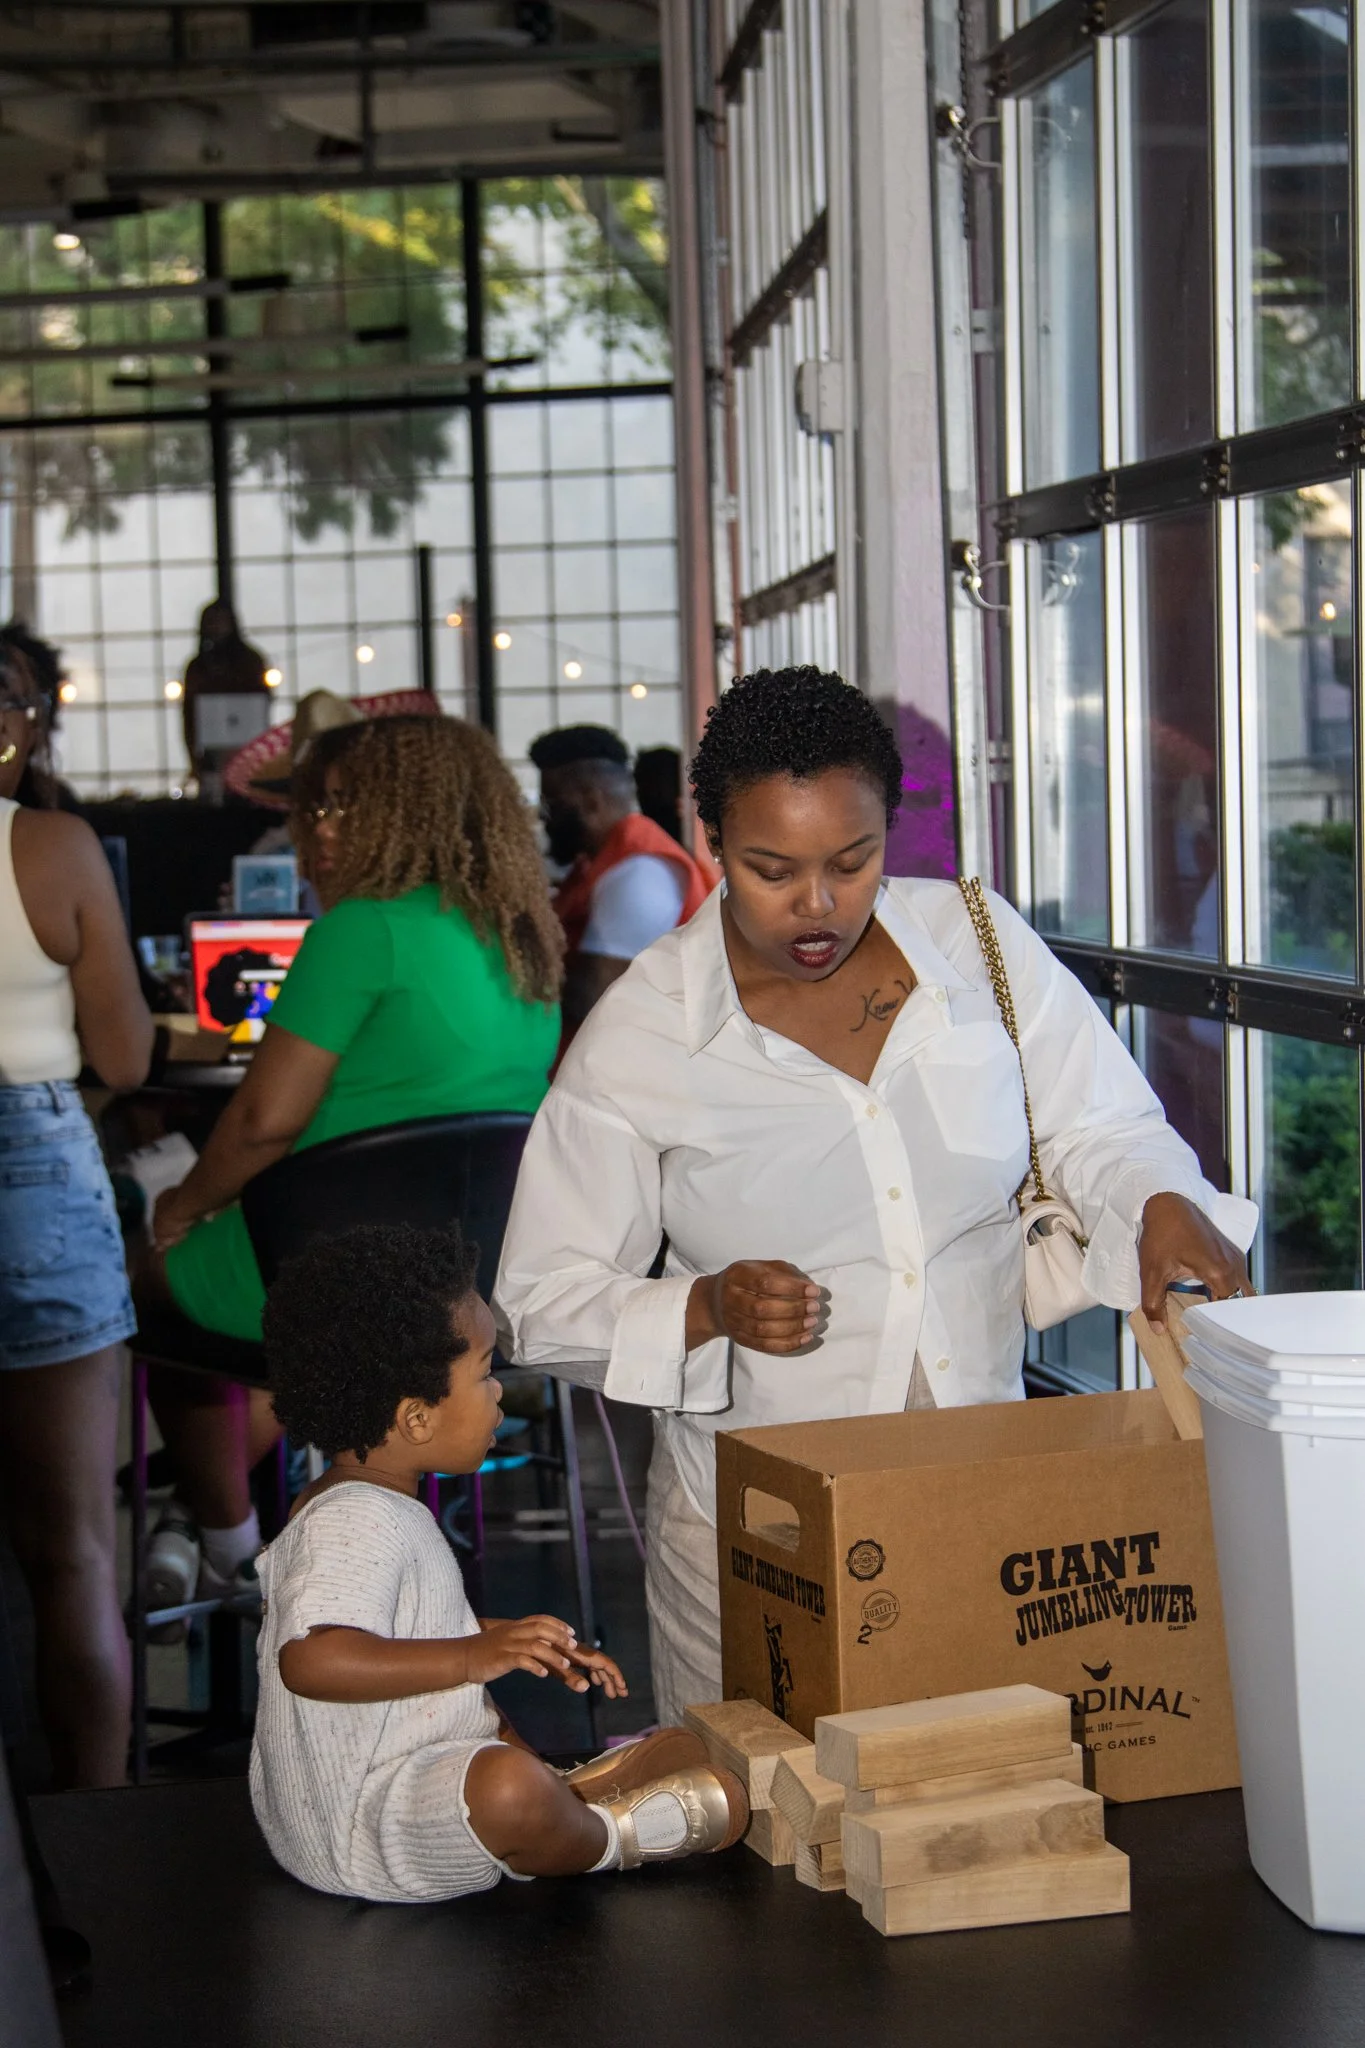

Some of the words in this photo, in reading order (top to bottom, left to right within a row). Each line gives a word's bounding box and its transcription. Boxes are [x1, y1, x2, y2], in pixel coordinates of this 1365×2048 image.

[853, 1555, 878, 1565] AUTHENTIC
[1000, 1532, 1160, 1596] GIANT
[731, 1546, 754, 1584] GIANT
[755, 1557, 795, 1603] JUMBLING
[795, 1575, 826, 1616] TOWER
[864, 1601, 897, 1620] QUALITY
[1015, 1578, 1126, 1646] JUMBLING
[1124, 1584, 1197, 1626] TOWER
[856, 1624, 873, 1645] 2
[1062, 1685, 1191, 1720] RDINAL
[1107, 1735, 1157, 1750] GAMES
